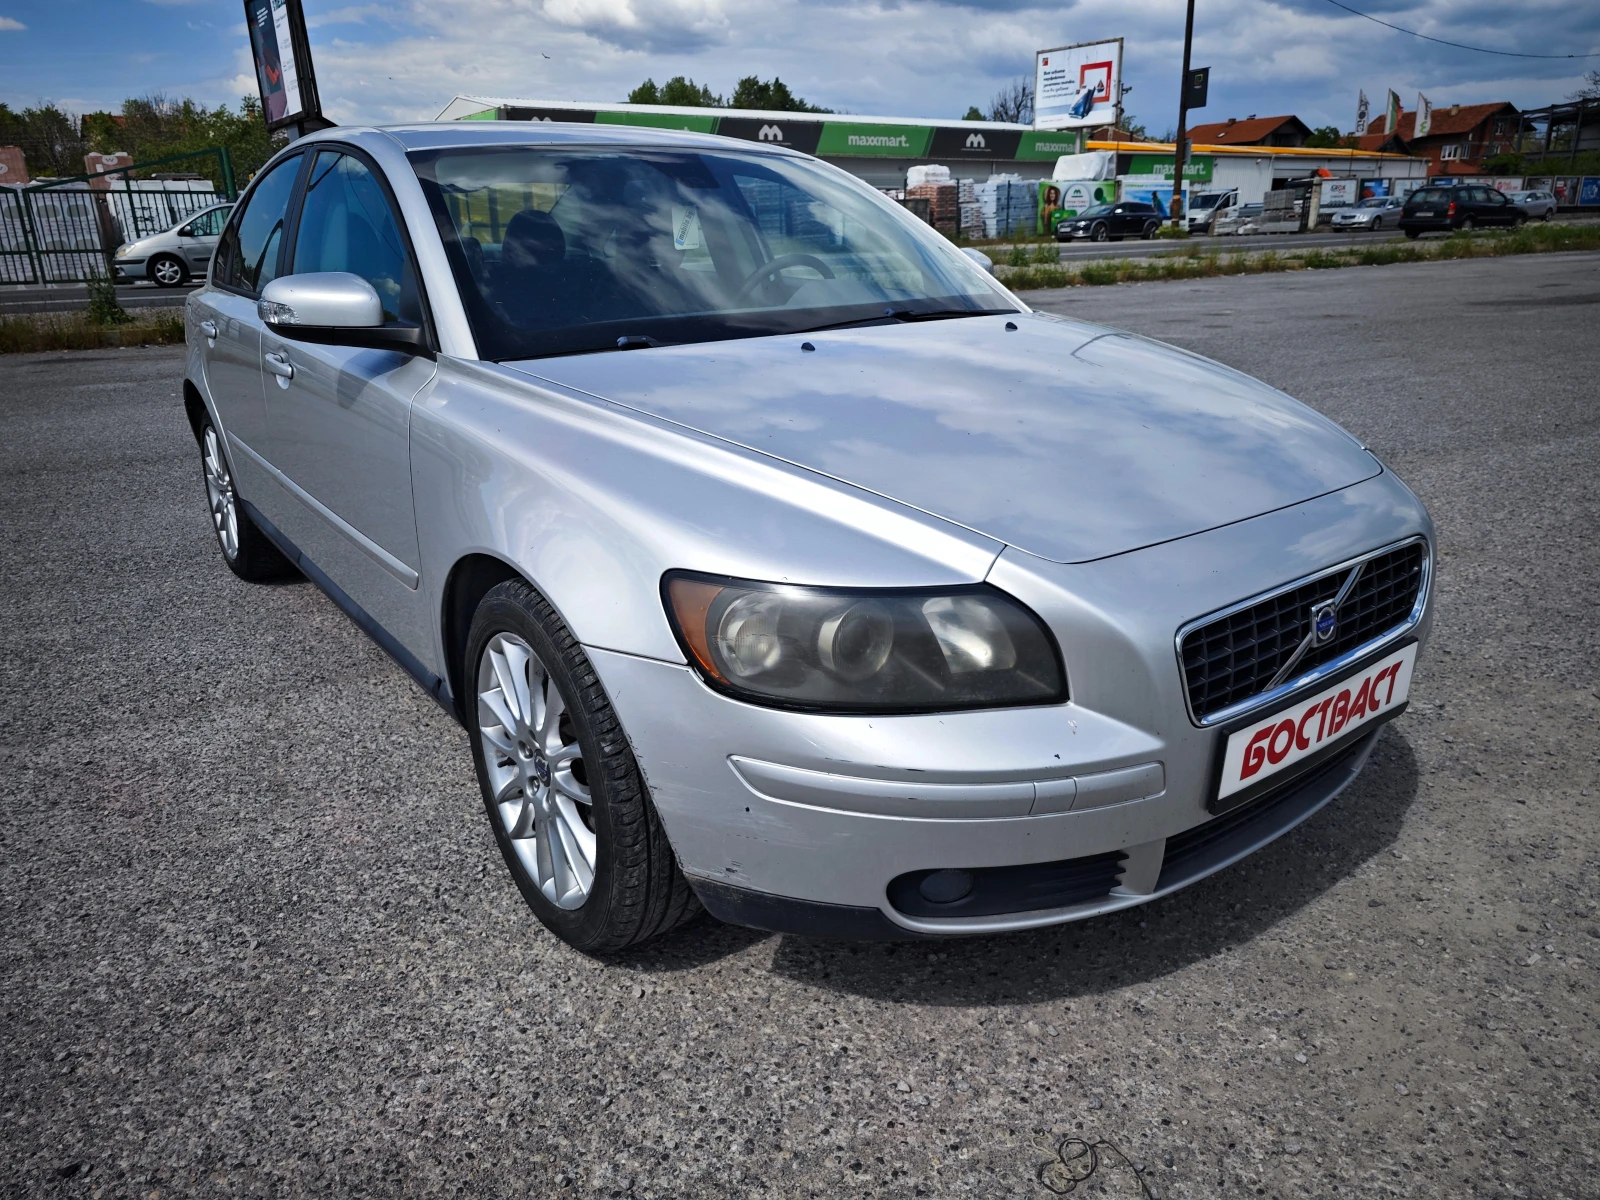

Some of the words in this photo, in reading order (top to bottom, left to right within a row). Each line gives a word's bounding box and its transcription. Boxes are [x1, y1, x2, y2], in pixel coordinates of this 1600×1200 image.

[848, 135, 909, 147] maxxmart.
[1035, 142, 1076, 152] maxxma
[1152, 163, 1206, 175] maxmart.
